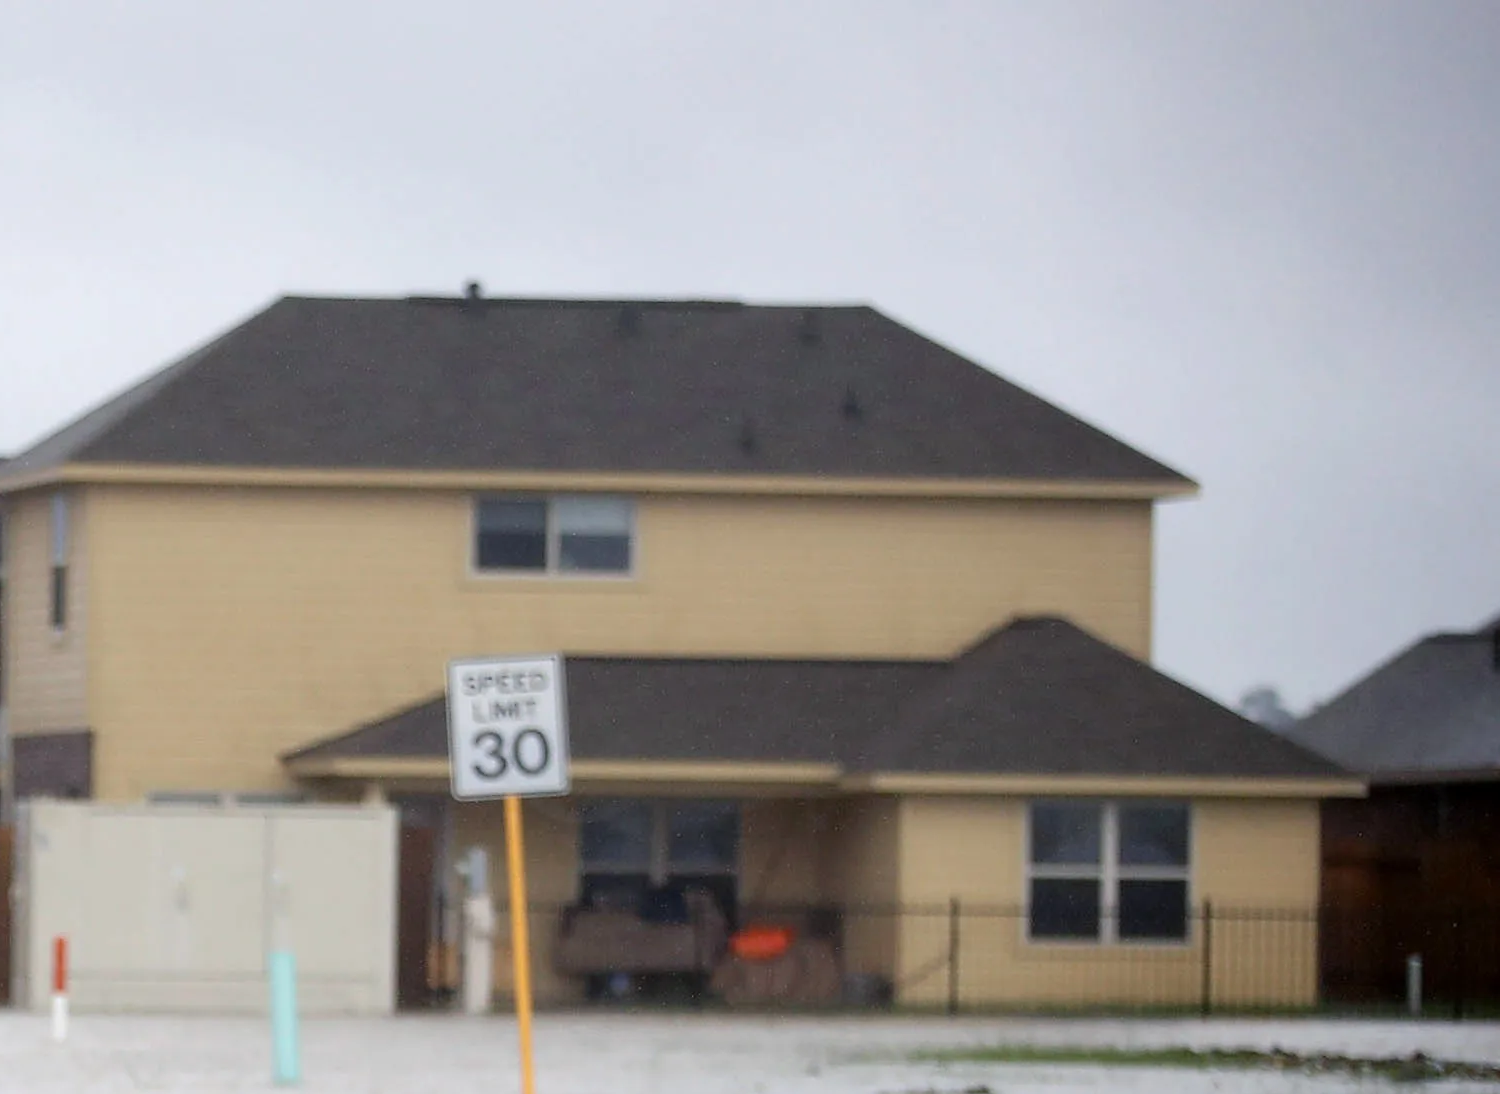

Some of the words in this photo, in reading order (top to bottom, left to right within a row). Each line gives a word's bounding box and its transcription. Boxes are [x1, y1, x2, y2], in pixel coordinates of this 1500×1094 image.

[461, 669, 549, 696] SPEED
[471, 697, 538, 724] LIMIT
[472, 727, 550, 780] 30
